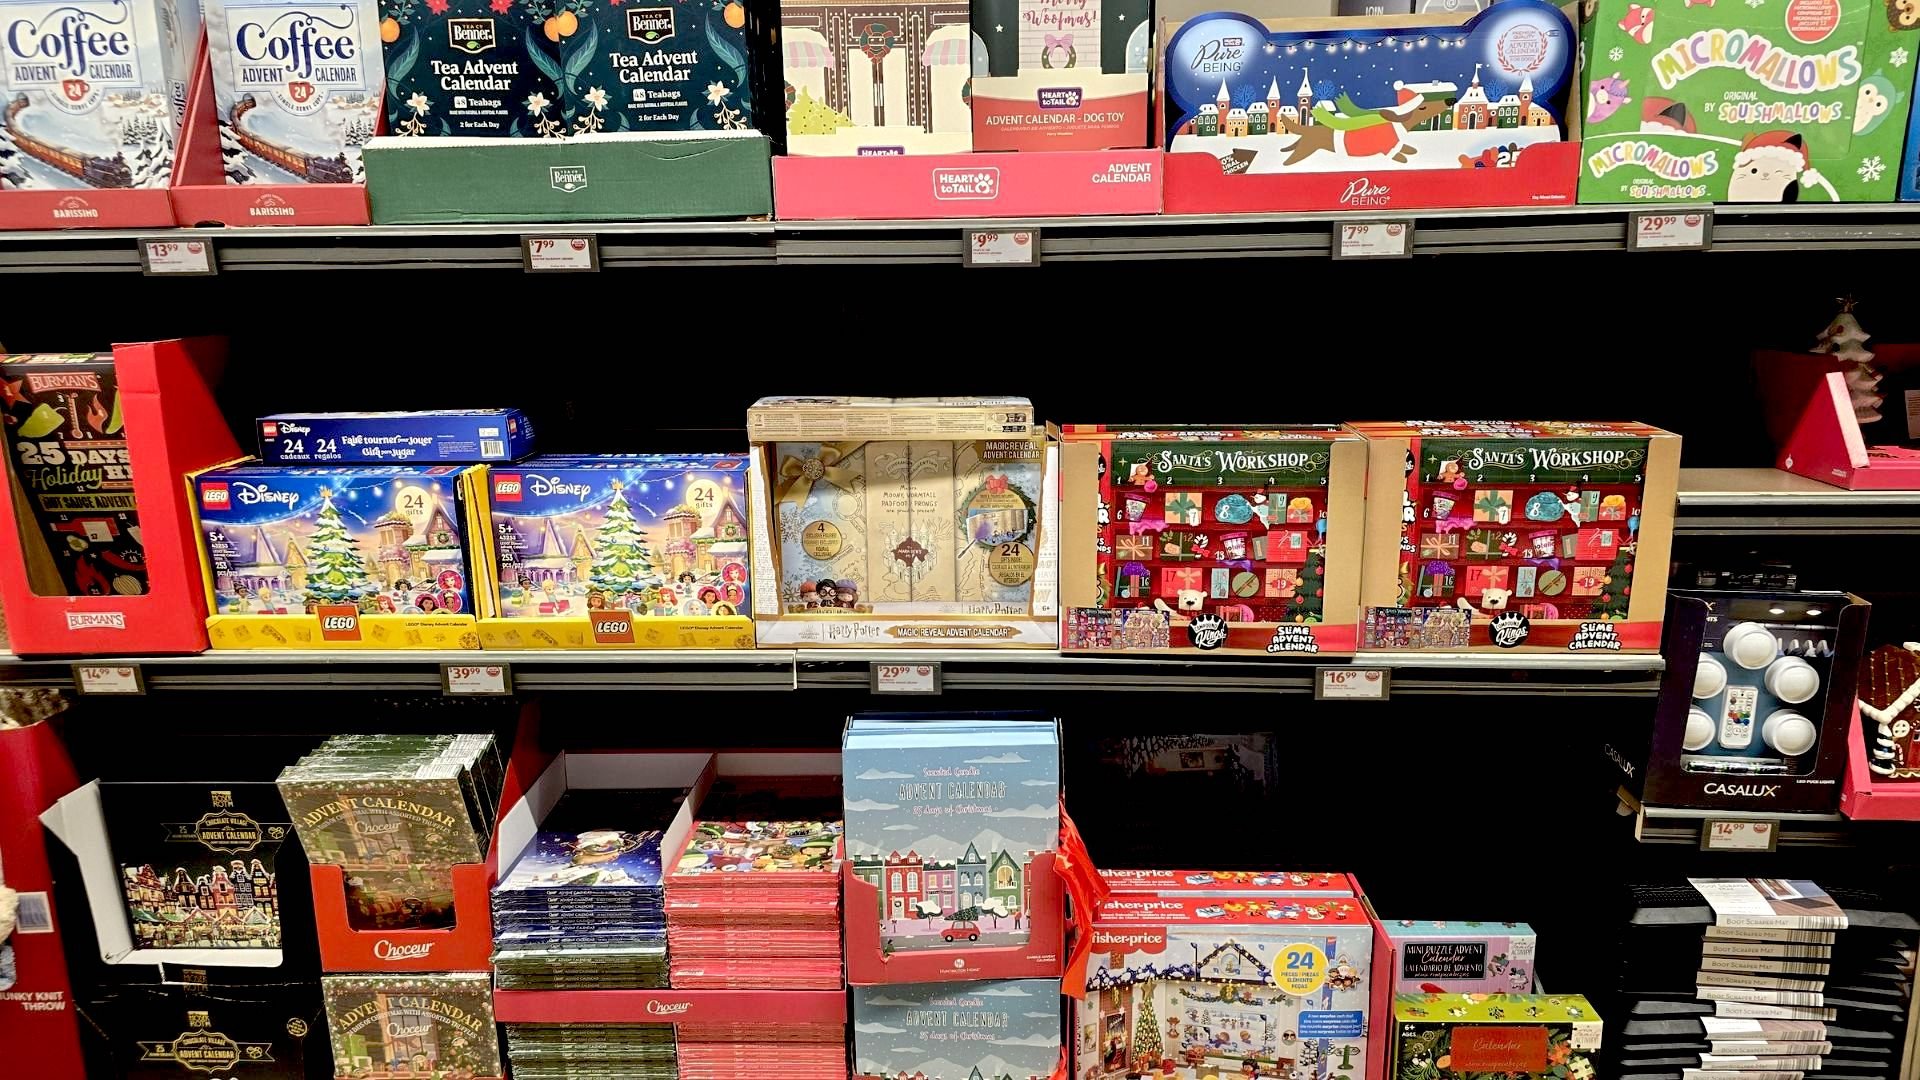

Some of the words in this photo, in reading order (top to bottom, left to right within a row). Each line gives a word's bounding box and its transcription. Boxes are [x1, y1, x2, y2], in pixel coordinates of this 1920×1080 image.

[632, 15, 669, 31] Benner
[1022, 8, 1097, 31] Woofmas!
[453, 25, 490, 40] Benner
[8, 16, 129, 76] Coffee
[236, 20, 355, 79] Coffee
[609, 52, 639, 67] Tea
[642, 49, 698, 66] Advent
[1190, 39, 1242, 70] Pure
[1653, 31, 1860, 92] MICROMALLOWS
[15, 65, 57, 81] ADVENT
[89, 64, 133, 79] CALENDAR
[430, 60, 460, 75] Tea
[463, 59, 519, 75] Advent
[619, 65, 691, 83] Calendar
[1203, 63, 1241, 73] BEING
[242, 68, 283, 83] ADVENT
[315, 66, 357, 82] CALENDAR
[440, 75, 511, 91] Calendar
[293, 86, 307, 99] 24
[1723, 91, 1759, 101] ORIGINAL
[468, 98, 502, 108] Teabags
[986, 115, 1022, 125] ADVENT
[1025, 114, 1076, 124] CALENDAR
[1083, 113, 1105, 123] DOG
[1107, 112, 1125, 122] TOY
[1704, 102, 1715, 112] BY
[1718, 101, 1843, 124] SQUISHMALLOWS
[1588, 141, 1719, 180] MICROMALLOWS
[1108, 163, 1152, 174] ADVENT
[554, 170, 583, 183] Benner
[940, 174, 974, 184] HEART
[1092, 173, 1152, 184] CALENDAR
[1340, 177, 1391, 204] Pure
[1629, 185, 1706, 199] SQUISHMALLOWS
[1351, 196, 1387, 206] BEING
[249, 206, 295, 217] BARISSIMO
[29, 374, 99, 390] BURMAN'S
[279, 421, 311, 436] Disney
[284, 438, 304, 453] 24
[316, 438, 337, 453] 24
[363, 435, 398, 445] tourner
[408, 435, 433, 448] jouer
[985, 441, 1010, 450] MAGIC
[1009, 441, 1038, 450] REVEAL
[17, 441, 66, 465] 25
[68, 449, 131, 465] DAYS
[314, 453, 342, 461] regalos
[392, 448, 416, 460] jugar
[983, 450, 1007, 459] ADVENT
[1008, 450, 1040, 459] CALENDAR
[1528, 447, 1625, 470] WORKSHOP
[1214, 450, 1309, 472] WORKSHOP
[26, 464, 102, 490] Holiday
[495, 481, 522, 494] LEGO
[525, 474, 591, 502] Disney
[694, 487, 714, 501] 24
[65, 495, 95, 509] SAUCE
[95, 495, 132, 508] ADVENT
[203, 489, 229, 502] LEGO
[232, 481, 300, 511] Disney
[404, 494, 424, 509] 24
[405, 508, 424, 516] gifts
[817, 523, 825, 533] 4
[209, 531, 225, 541] 5+
[1001, 543, 1020, 557] 24
[215, 561, 228, 570] 253
[69, 614, 124, 627] BURMAN'S
[323, 616, 356, 630] LEGO
[596, 621, 629, 634] LEGO
[1580, 622, 1614, 632] SLIME
[828, 623, 853, 639] Harry
[853, 622, 881, 638] Potter
[897, 628, 919, 637] MAGIC
[919, 628, 945, 637] REVEAL
[946, 628, 972, 637] ADVENT
[973, 628, 1008, 637] CALENDAR
[1277, 625, 1310, 635] SLIME
[1495, 624, 1528, 646] Kings
[1574, 631, 1618, 641] ADVENT
[1272, 634, 1314, 644] ADVENT
[1568, 639, 1621, 651] CALENDAR
[1267, 642, 1318, 654] CALENDAR
[953, 765, 980, 777] Candle
[899, 782, 943, 801] ADVENT
[947, 780, 1006, 800] CALENDAR
[1703, 782, 1777, 798] CASALUX
[302, 797, 358, 828] ADVENT
[362, 796, 456, 828] CALENDAR
[923, 804, 943, 817] days
[954, 803, 993, 815] Christmas
[205, 818, 230, 826] CHOCOLATE
[354, 821, 401, 835] Choceur
[202, 831, 225, 840] ADVENT
[226, 831, 257, 840] CALENDAR
[373, 939, 433, 960] Choceur
[1406, 945, 1424, 955] MINI
[1425, 945, 1453, 955] PUZZLE
[1454, 945, 1483, 955] ADVENT
[1286, 951, 1314, 970] 24
[1421, 951, 1466, 964] Calendar
[1405, 964, 1442, 972] CALENDARIO
[1453, 964, 1483, 972] ADVIENTO
[35, 991, 64, 1001] KNIT
[21, 1001, 66, 1011] THROW
[646, 1000, 691, 1015] Choceur
[338, 997, 395, 1031] ADVENT
[398, 996, 483, 1032] CALENDAR
[386, 1022, 433, 1038] Choceur
